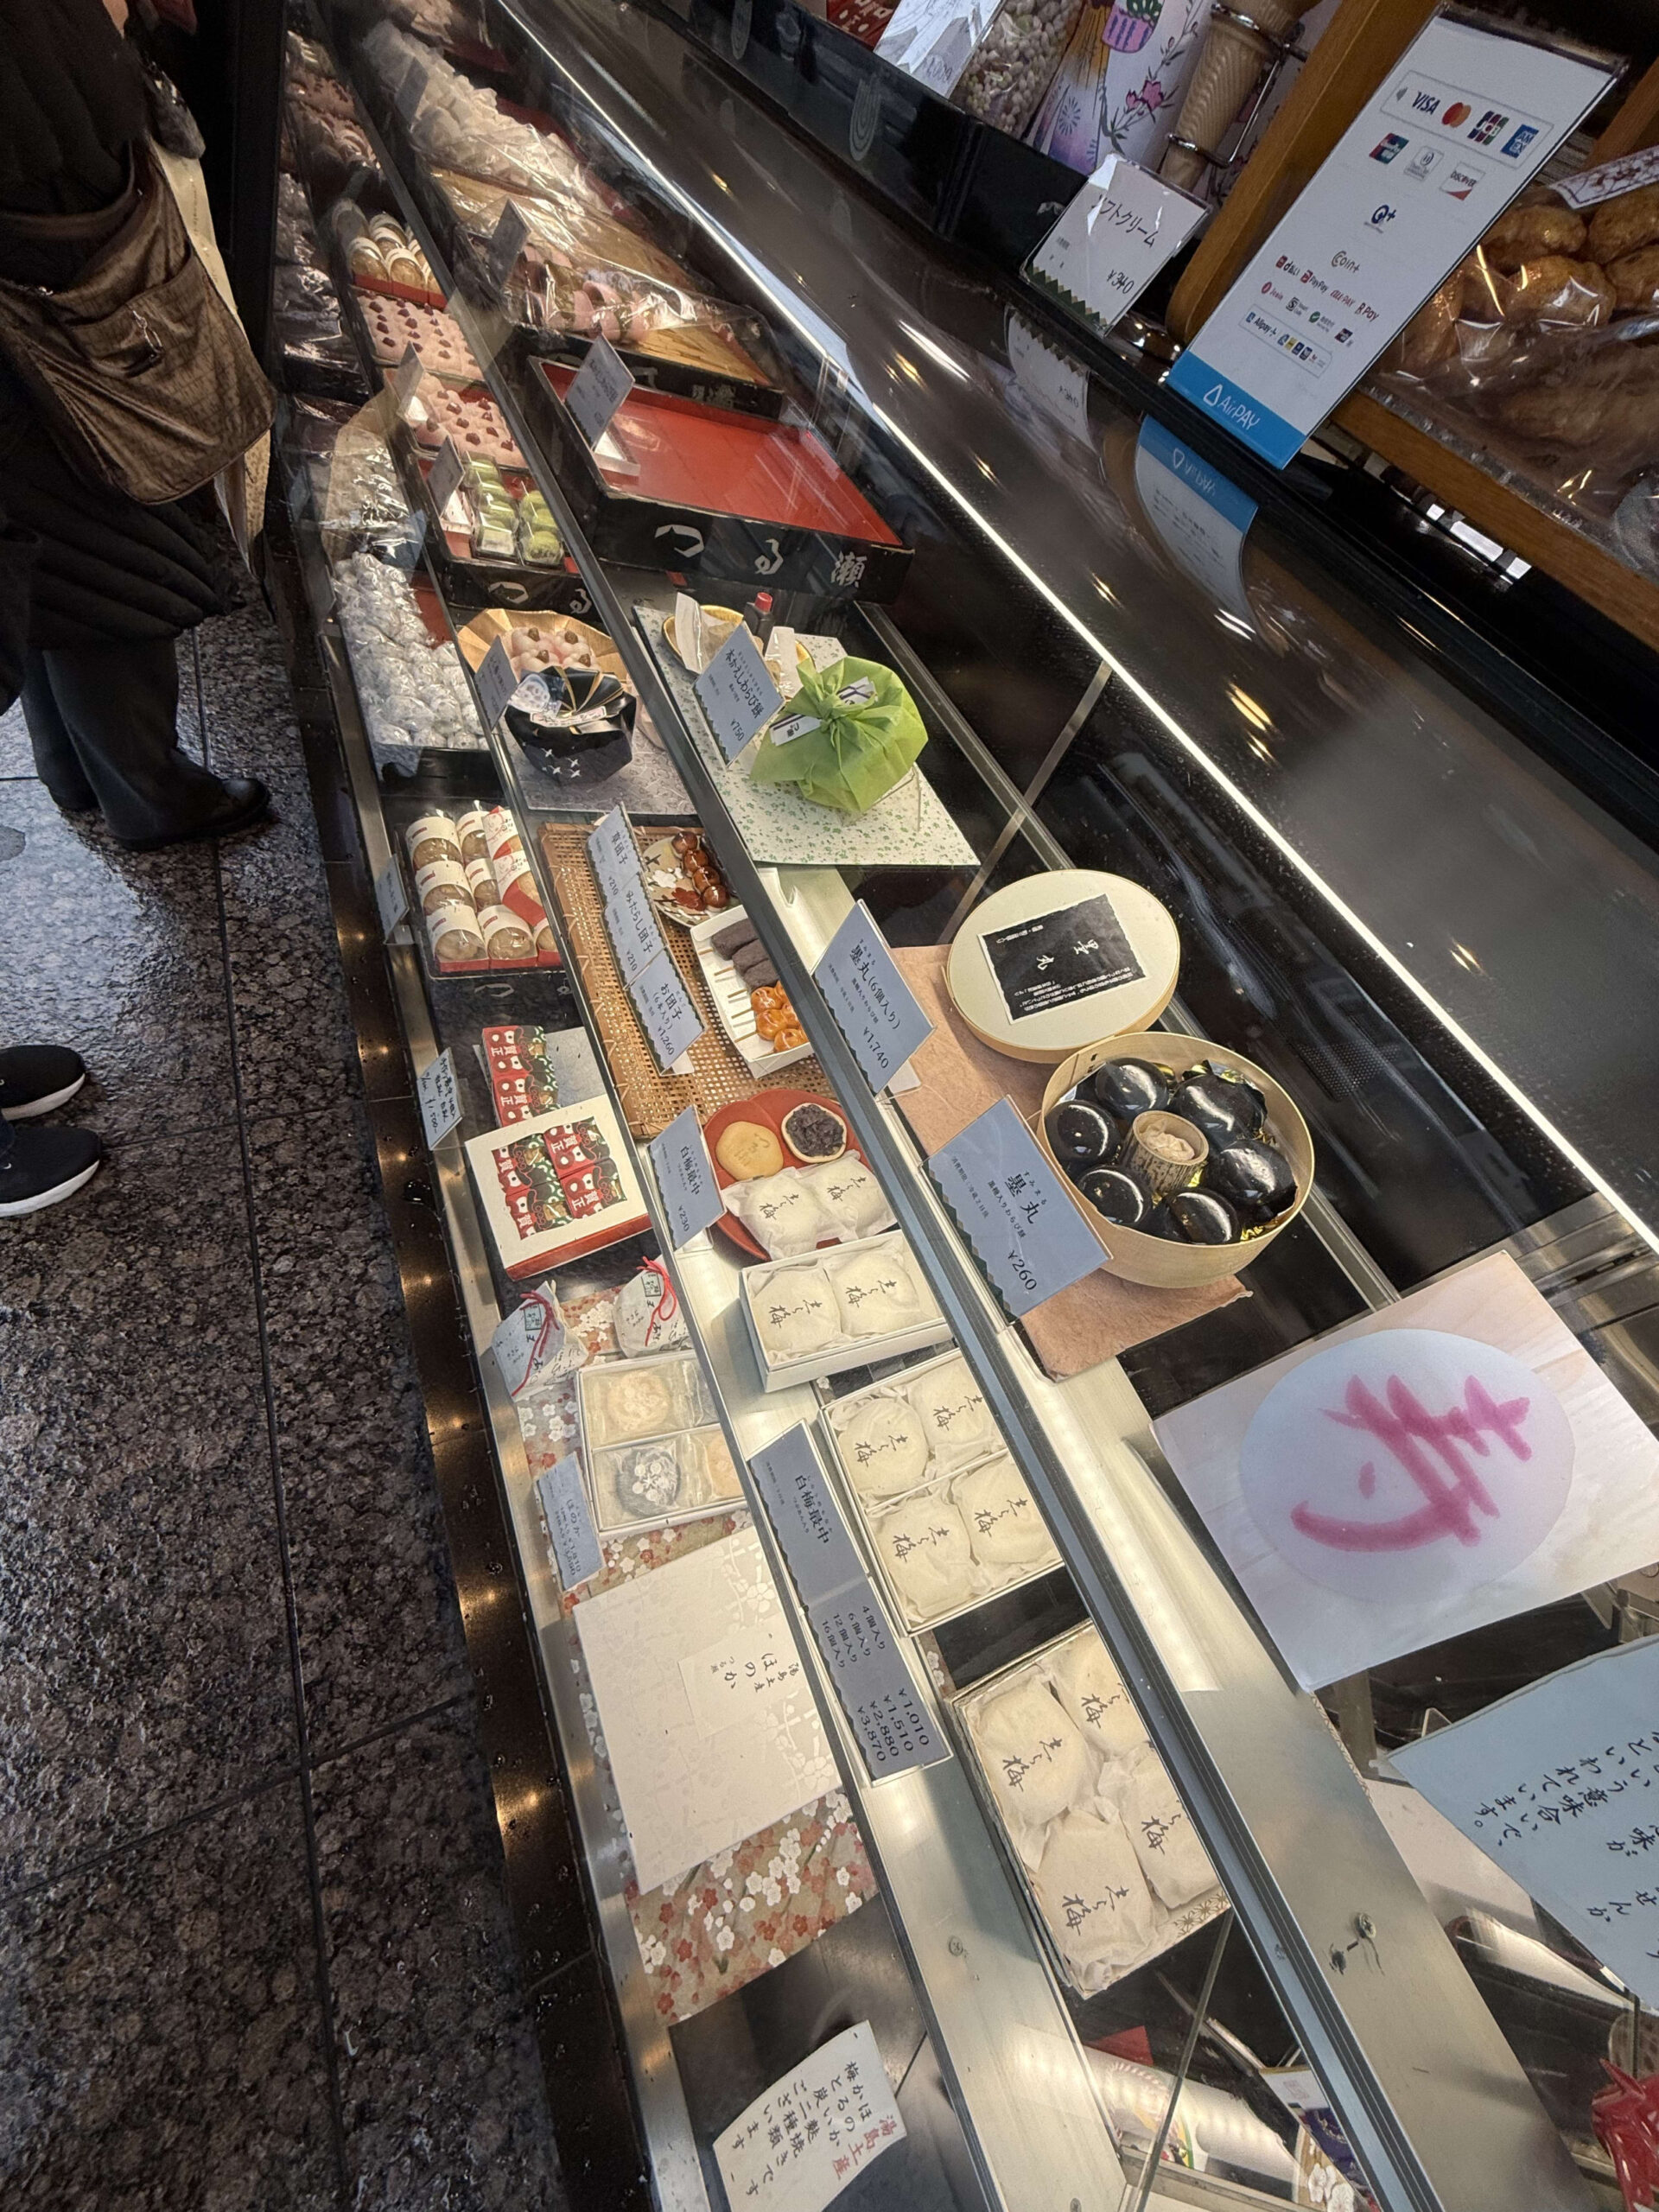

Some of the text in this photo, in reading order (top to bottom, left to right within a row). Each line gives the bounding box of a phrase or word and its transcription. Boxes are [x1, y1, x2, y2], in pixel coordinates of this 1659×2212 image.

[1411, 91, 1440, 115] VISA
[1475, 121, 1502, 137] JCB
[1106, 269, 1135, 295] ¥340
[1219, 391, 1262, 431] AirPAY
[725, 649, 765, 719] 本かえしわらび餅
[610, 830, 626, 865] 草団子
[608, 876, 620, 896] ¥210
[626, 889, 654, 953] みたらし団子
[626, 950, 639, 971] ¥210
[660, 982, 683, 1020] お団子
[658, 1026, 675, 1055] ¥1,260
[862, 1026, 889, 1069] ¥1,740
[680, 1145, 701, 1195] 白梅最中
[1023, 1170, 1048, 1206] すみまる
[678, 1204, 690, 1232] ¥230
[988, 1180, 1027, 1238] 黒糖入りわらび餅
[1007, 1249, 1038, 1291] ¥260
[795, 1474, 830, 1543] 白梅最中
[724, 1652, 778, 1689] ほのか
[823, 1620, 887, 1761] 16個入り ¥3,870
[833, 1613, 899, 1756] 12個入り ¥2,880
[849, 1612, 914, 1751] 6個入り ¥1,510
[863, 1605, 930, 1745] 4個入り ¥1,010
[1586, 1886, 1659, 1923] せんか
[732, 2080, 807, 2150] ございます
[767, 2061, 860, 2149] 梅と炭二種類
[829, 2102, 873, 2147] ほのか
[832, 2115, 897, 2180] 湯島土産
